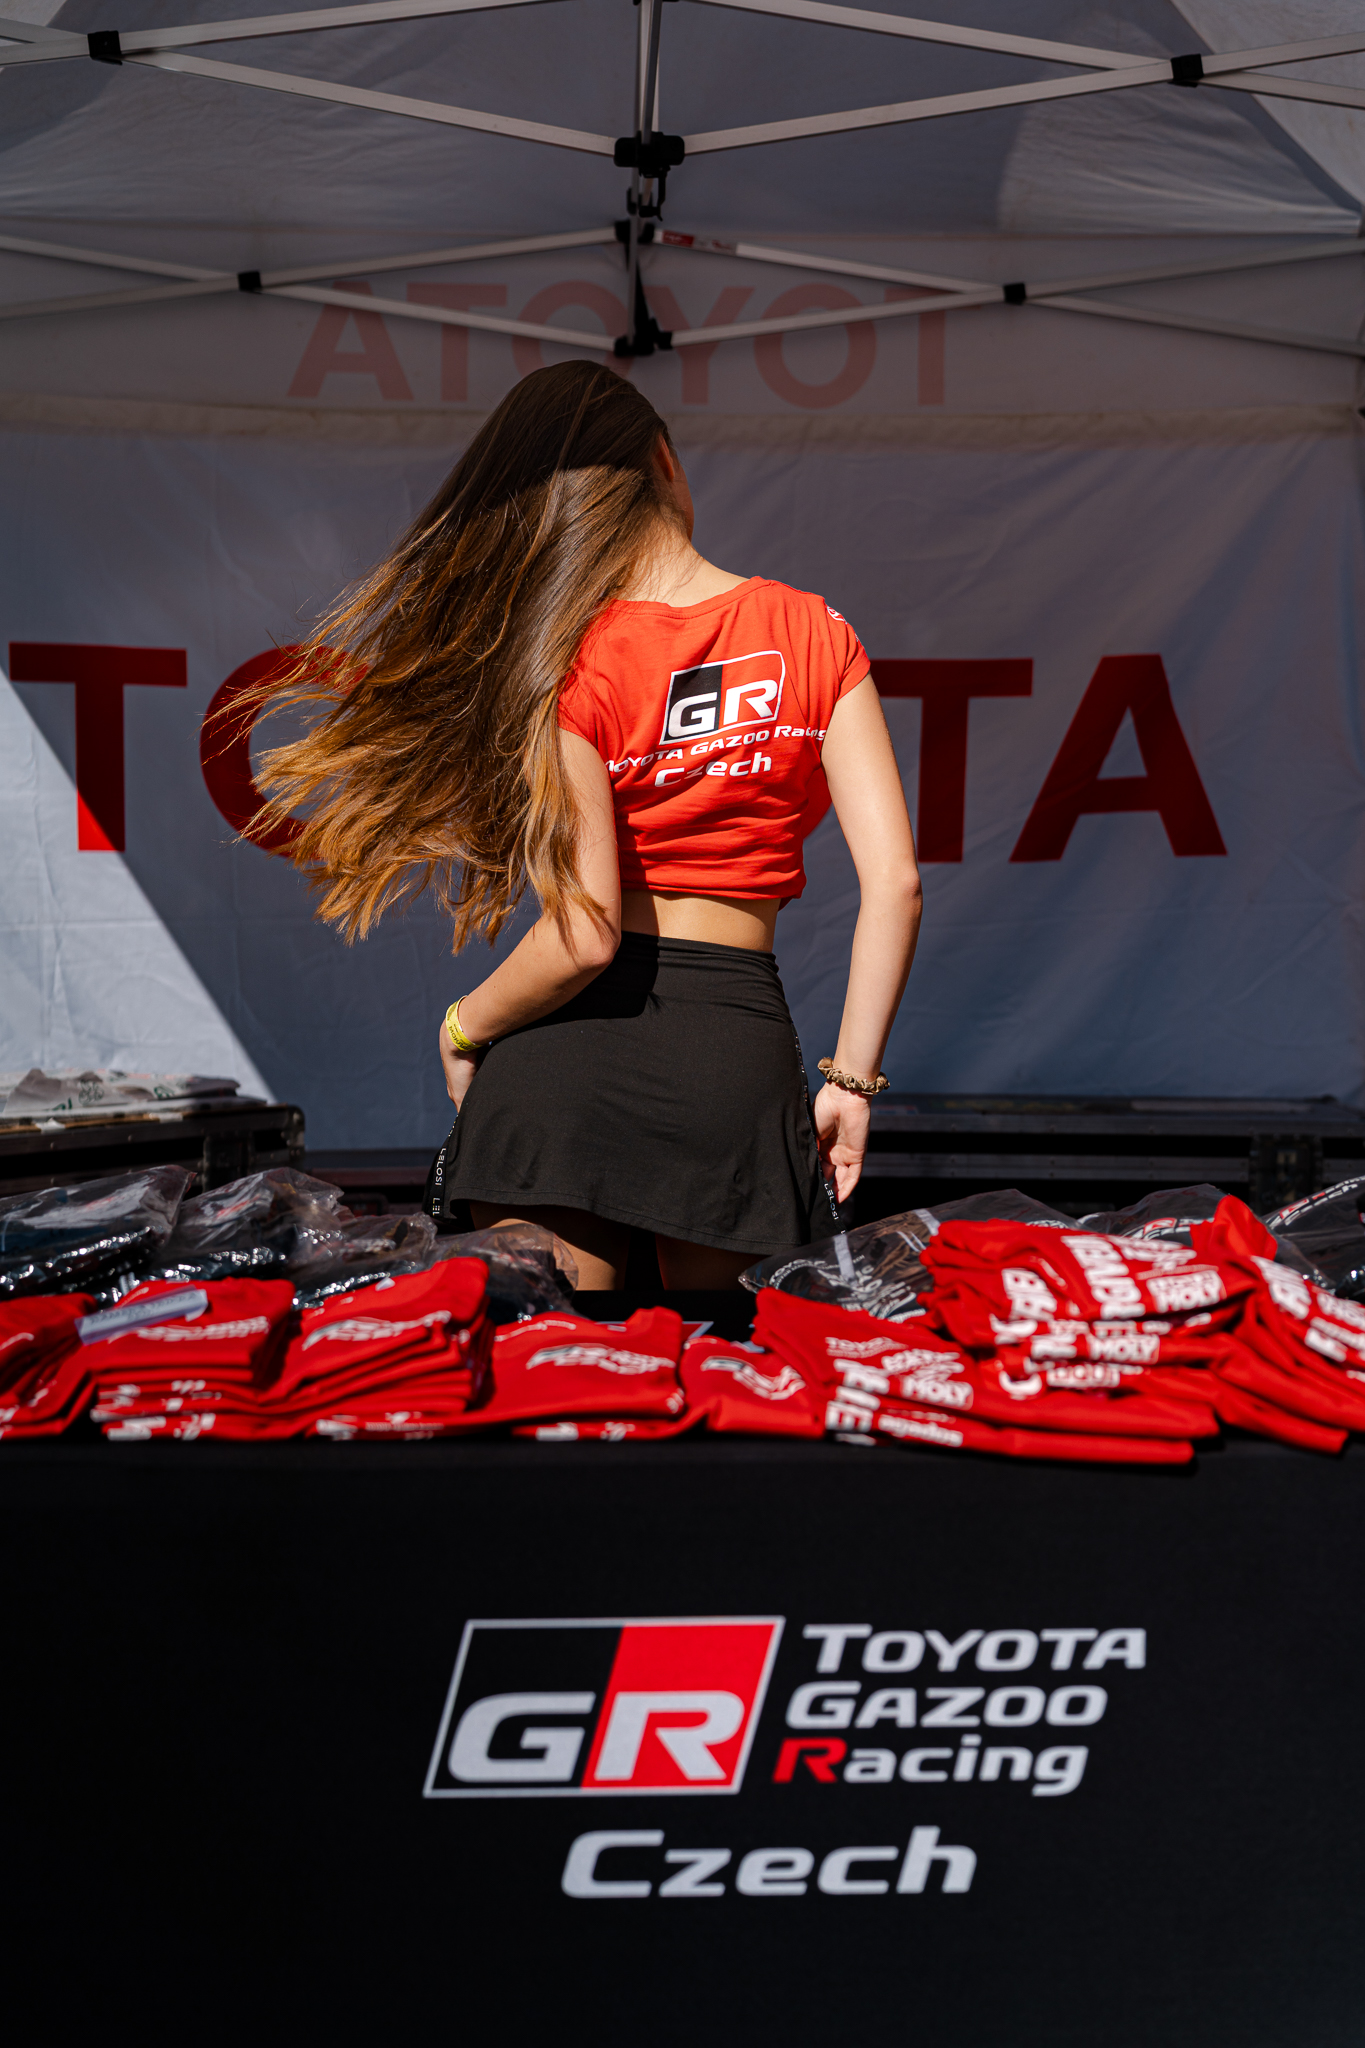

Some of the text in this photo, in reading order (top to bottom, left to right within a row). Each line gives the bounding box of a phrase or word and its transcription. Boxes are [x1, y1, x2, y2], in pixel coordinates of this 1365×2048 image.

[668, 680, 779, 738] GR
[690, 729, 770, 756] GAZOO
[802, 1623, 1147, 1674] TOYOTA
[785, 1680, 1109, 1729] GAZOO
[447, 1690, 746, 1783] GR
[772, 1733, 1090, 1797] Racing
[561, 1825, 978, 1899] Czech
